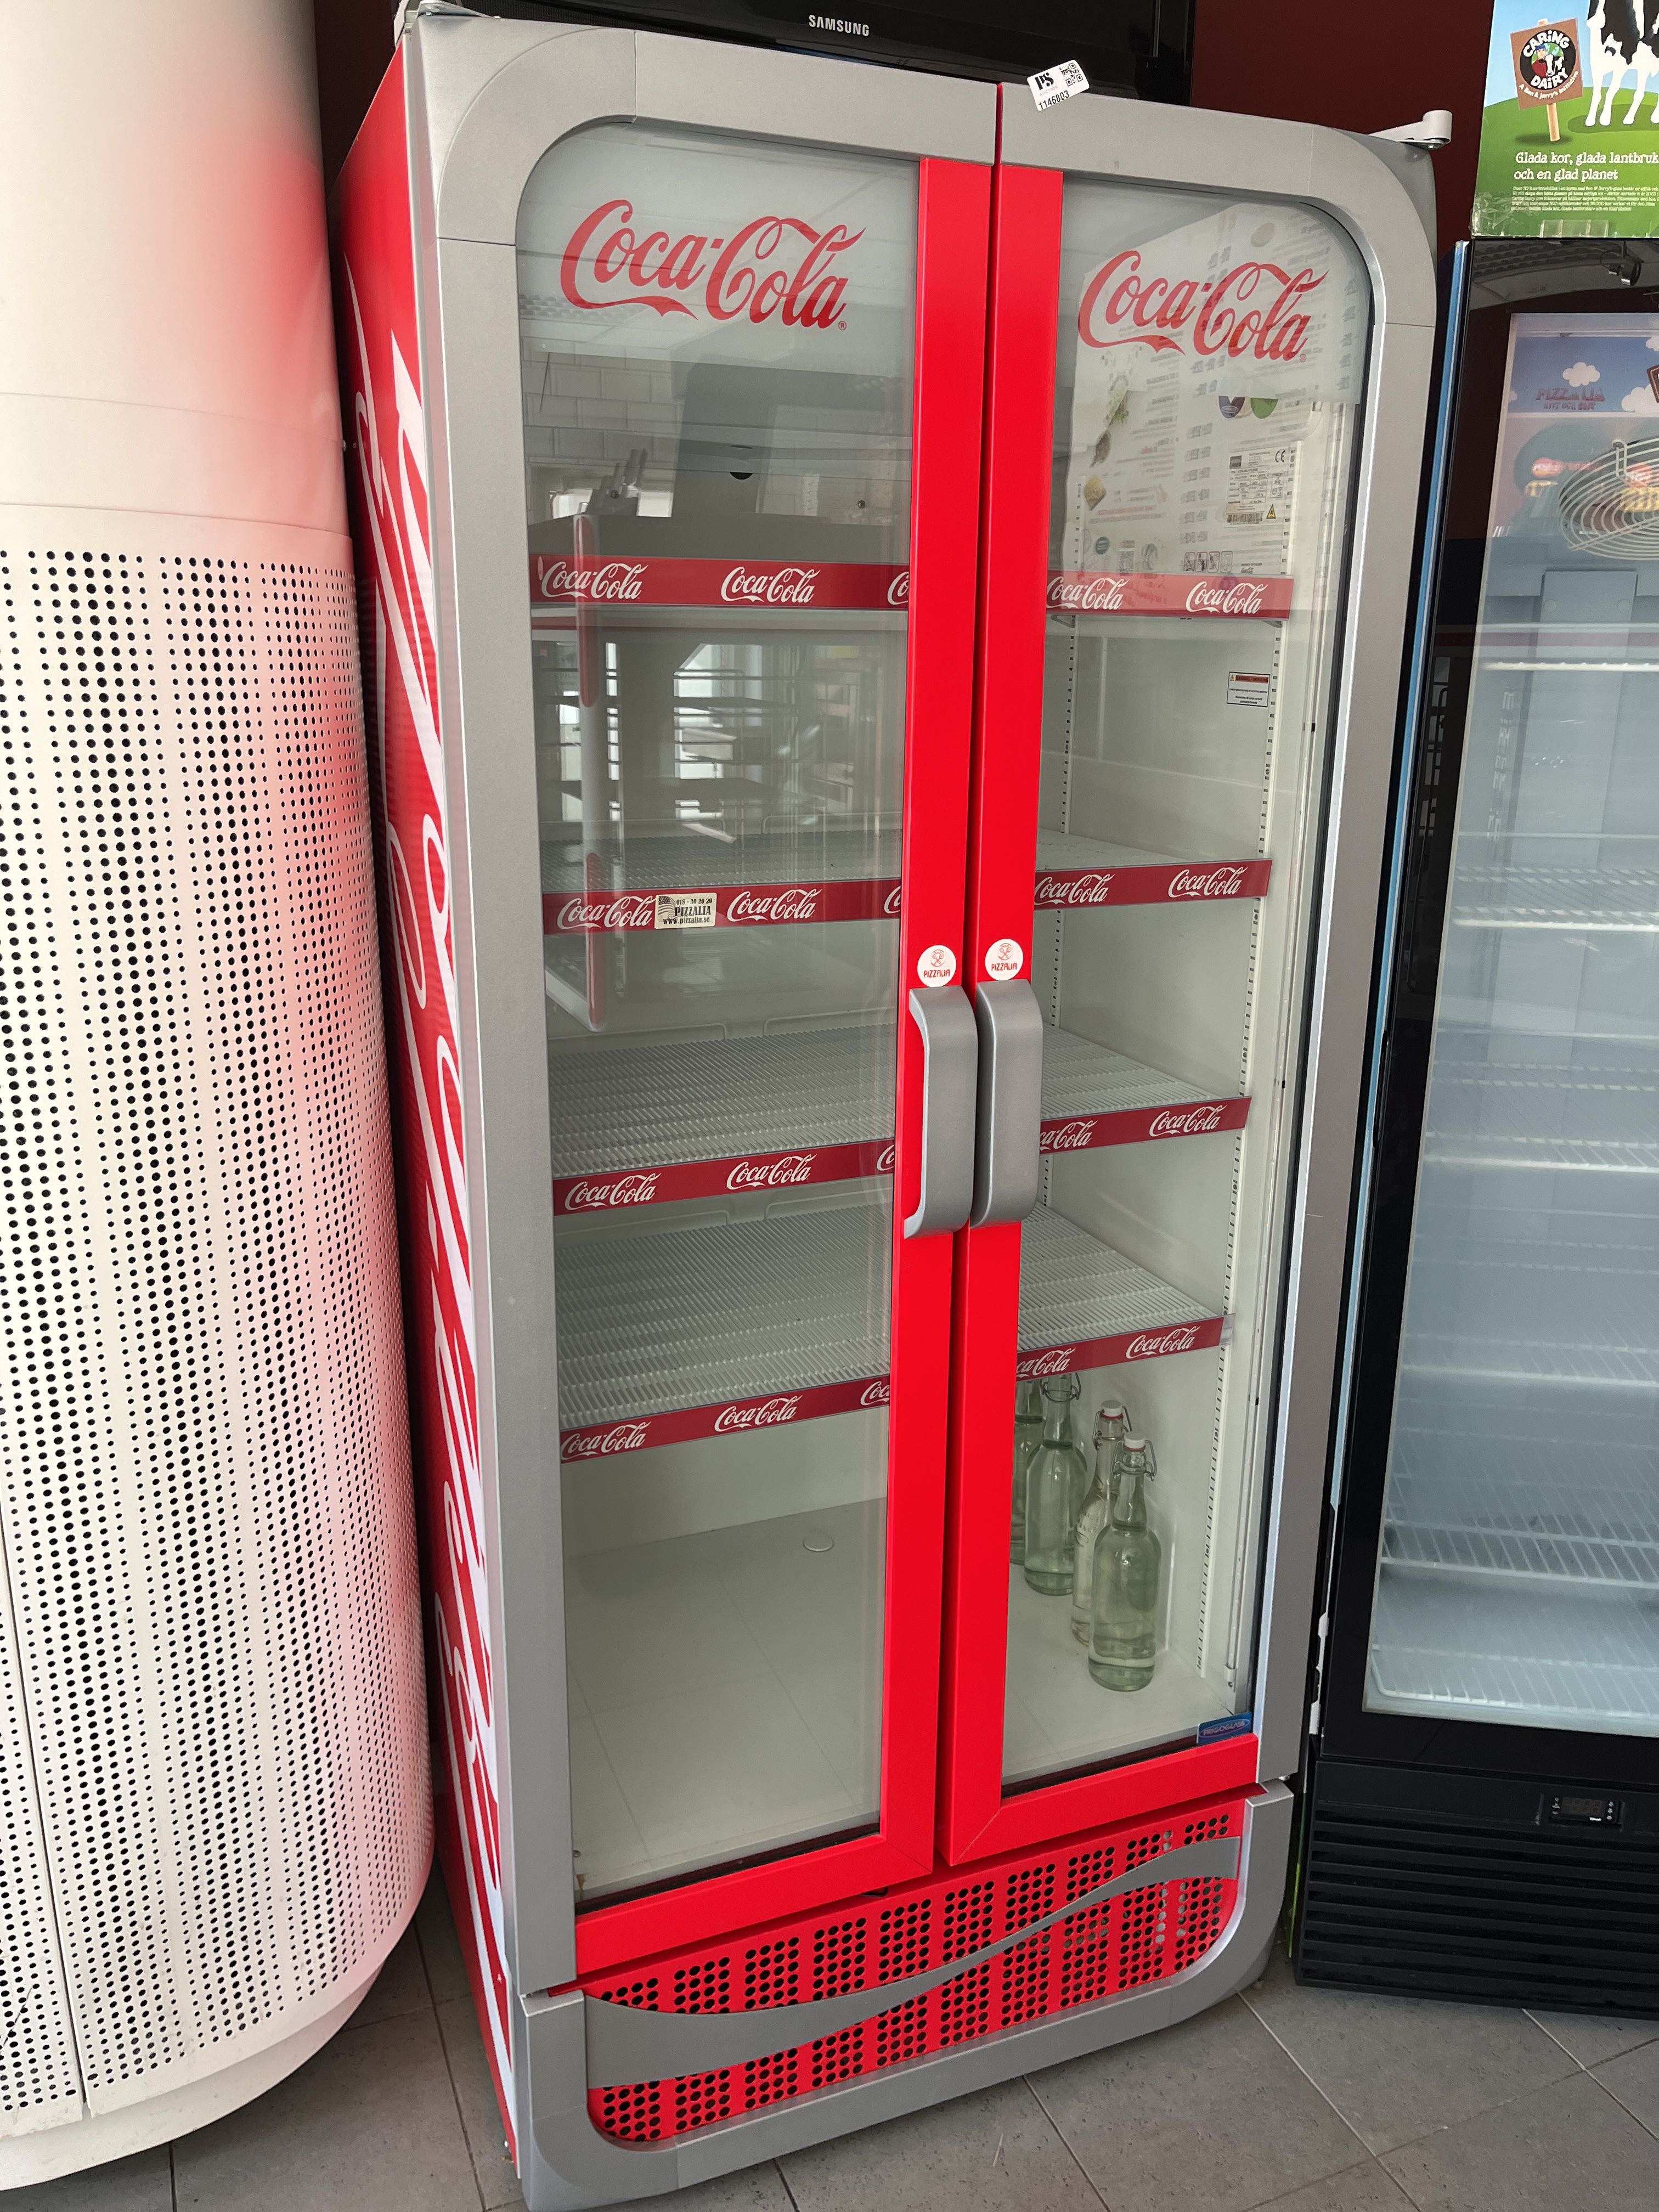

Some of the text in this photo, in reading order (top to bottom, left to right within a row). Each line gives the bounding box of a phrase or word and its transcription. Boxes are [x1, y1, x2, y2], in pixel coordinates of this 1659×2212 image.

[809, 15, 869, 36] SAMSUNG
[1039, 90, 1069, 110] 1146803
[1539, 90, 1559, 99] Jerry's
[1515, 151, 1659, 166] Glada kor, glada lantbruk
[1514, 168, 1618, 182] och en glad planet
[560, 199, 867, 329] Coca-Cola
[1077, 250, 1330, 362] Coca-Cola
[541, 561, 821, 603] Coca-Cola Coca-Cola
[1047, 575, 1269, 614] Coca-Cola Coca-Cola
[1034, 866, 1249, 906] Coca-Cola Coca-Cola
[557, 888, 823, 930] Coca-Cola Coca-Cola
[663, 917, 710, 925] www.pizzalia.se
[674, 906, 711, 917] PIZZALIA
[923, 969, 950, 978] PIZZALIA
[991, 962, 1017, 971] PIZZALIA
[1039, 1104, 1227, 1152] ca-Cola Coca-Cola
[565, 1153, 818, 1211] Coca-Cola Coca-Cola
[1016, 1325, 1201, 1379] ca-Cola Coca-Cola
[561, 1394, 803, 1460] Coca-Cola Coca-Cola
[1203, 1720, 1246, 1736] FRIGOGLASS
